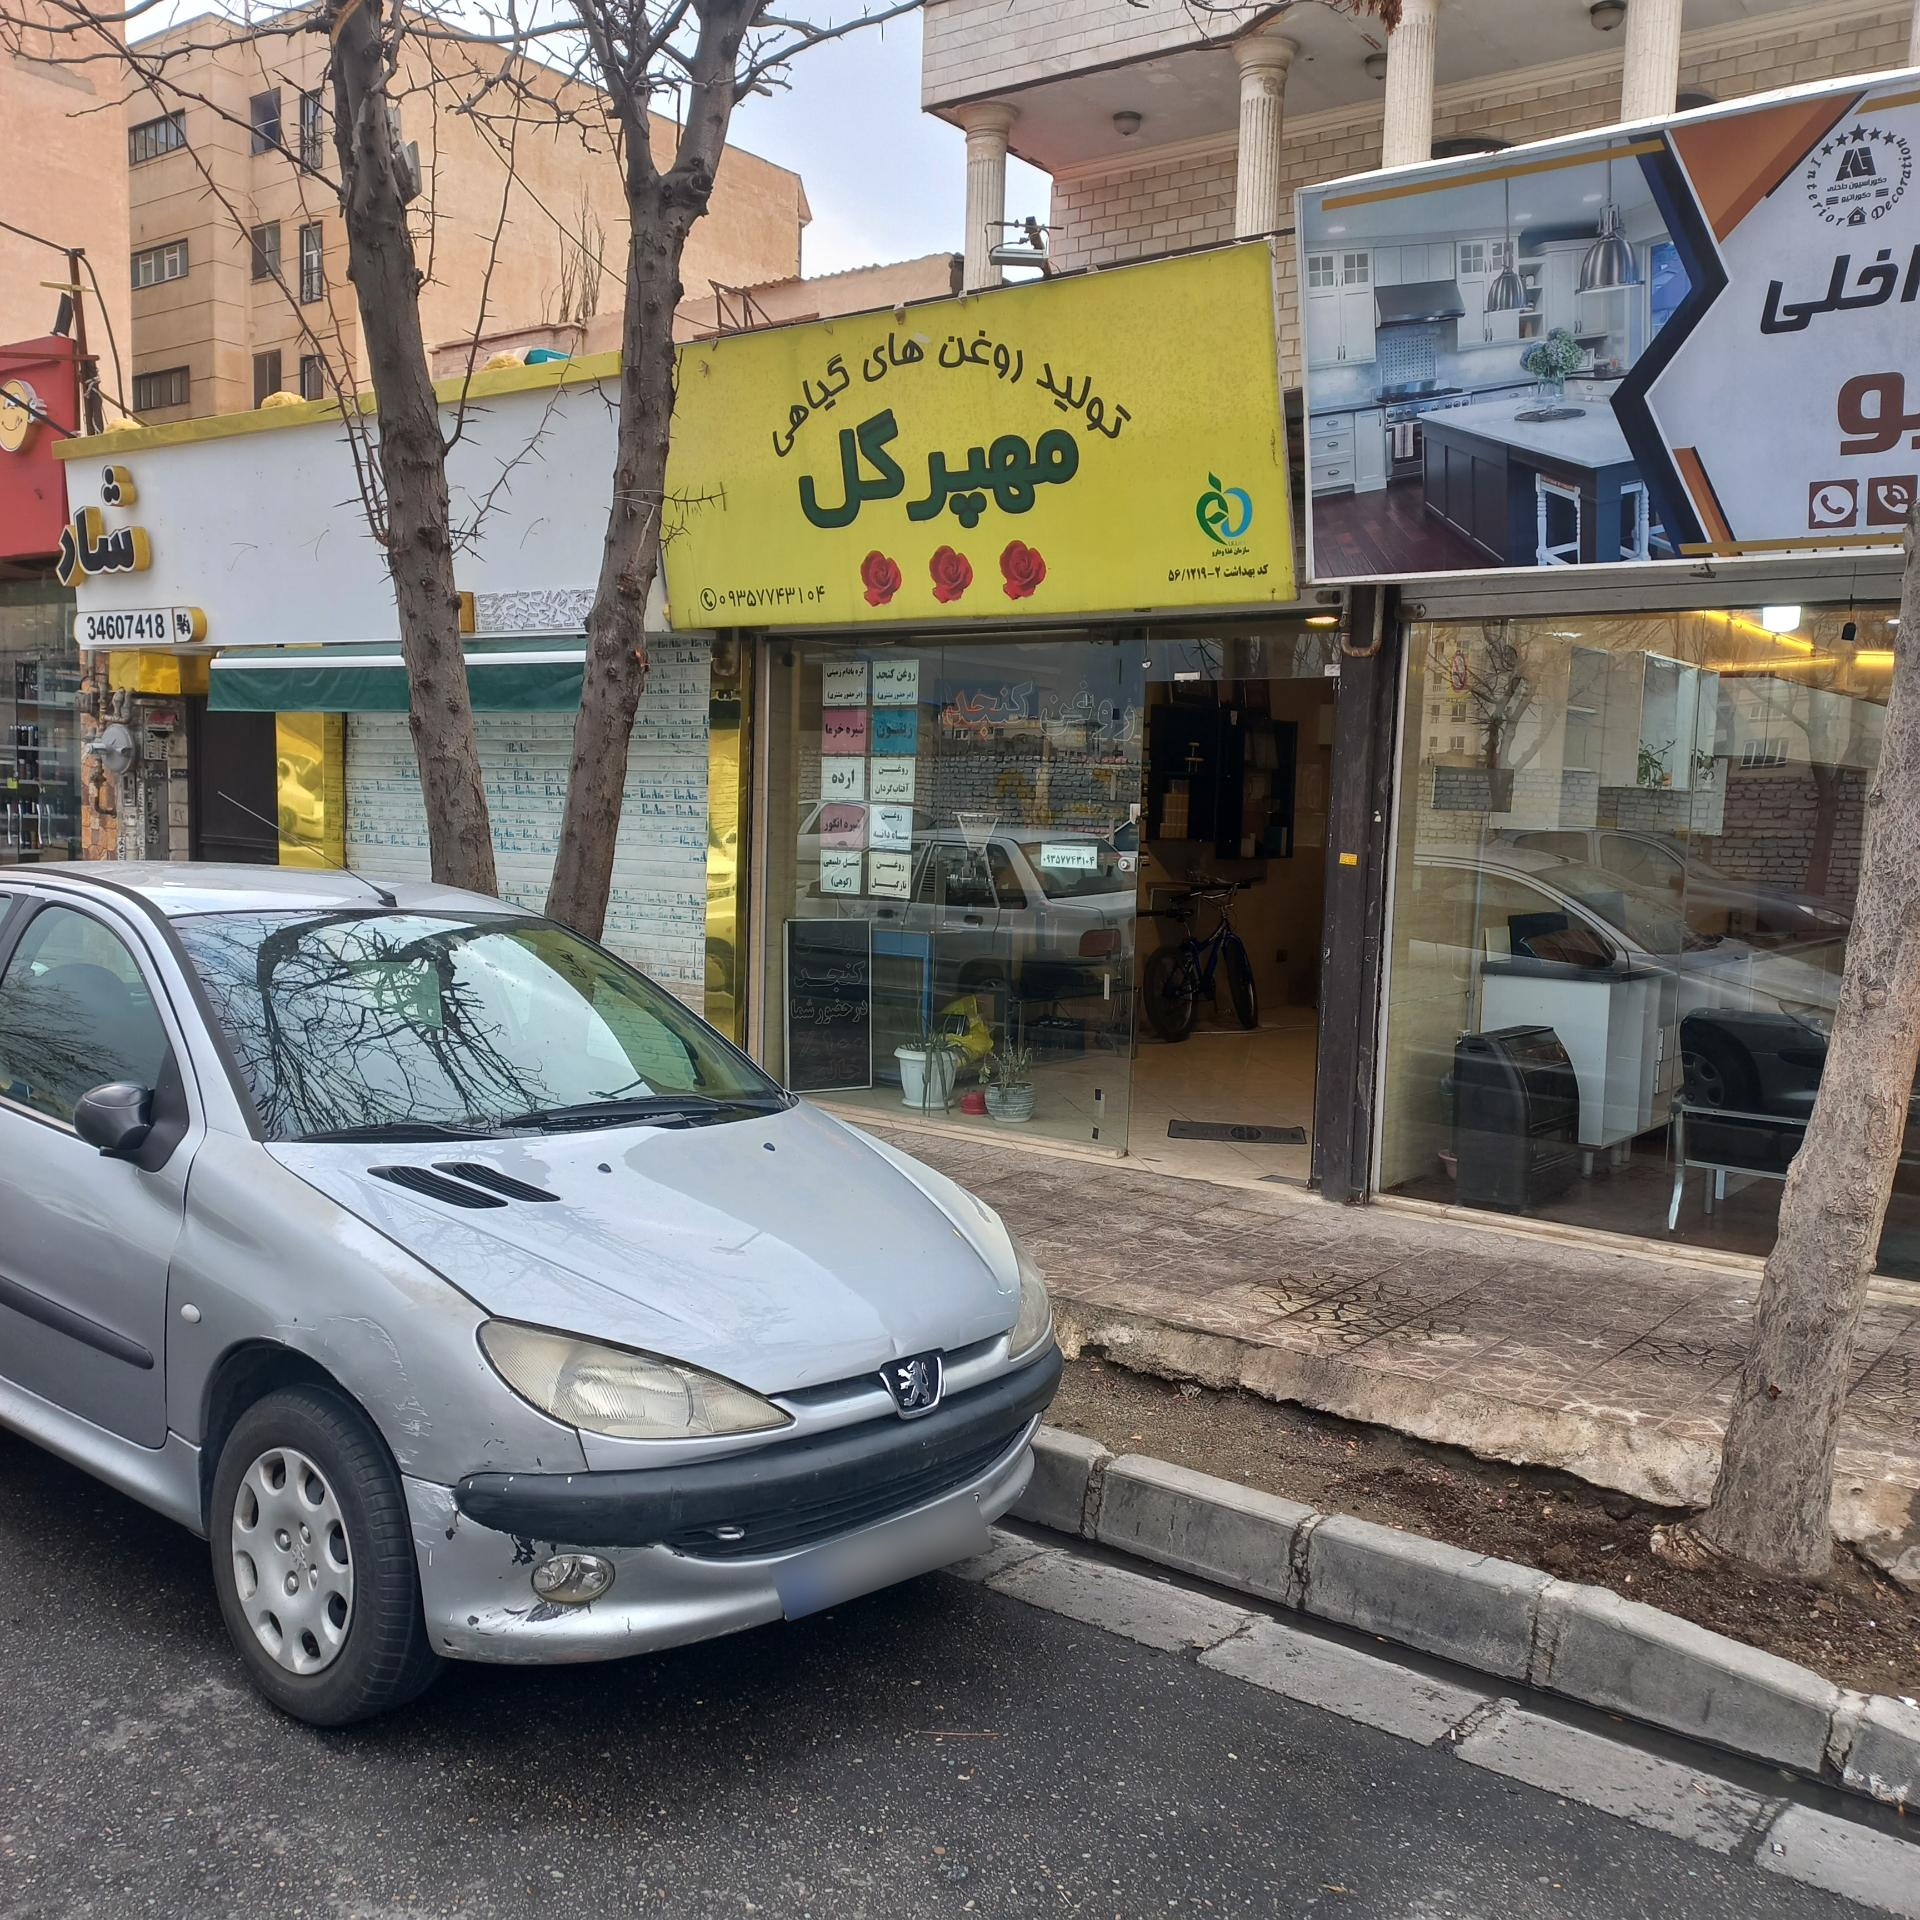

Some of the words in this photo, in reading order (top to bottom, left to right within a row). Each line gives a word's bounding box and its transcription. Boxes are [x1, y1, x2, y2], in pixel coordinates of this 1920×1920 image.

[1806, 157, 1846, 226] Interior
[1871, 138, 1913, 220] Decoration
[1760, 244, 1920, 335] اخلی
[863, 332, 924, 383] های
[939, 330, 1023, 383] روغن
[773, 353, 850, 458] گیاهی
[1036, 363, 1131, 439] تولید
[1223, 565, 1255, 578] بهداشت
[1257, 564, 1269, 576] کد
[719, 585, 825, 607] ۰۹۳۵۷۷۴۳۱۰۴
[87, 613, 165, 640] 34607418
[876, 668, 895, 683] کنجد
[896, 668, 916, 682] روغن
[825, 723, 844, 738] خرما
[845, 722, 865, 738] شیره
[831, 768, 855, 789] ارده
[823, 817, 843, 832] انگور
[793, 960, 866, 993] کنجد
[790, 998, 815, 1019] شما
[815, 999, 854, 1025] حضور
